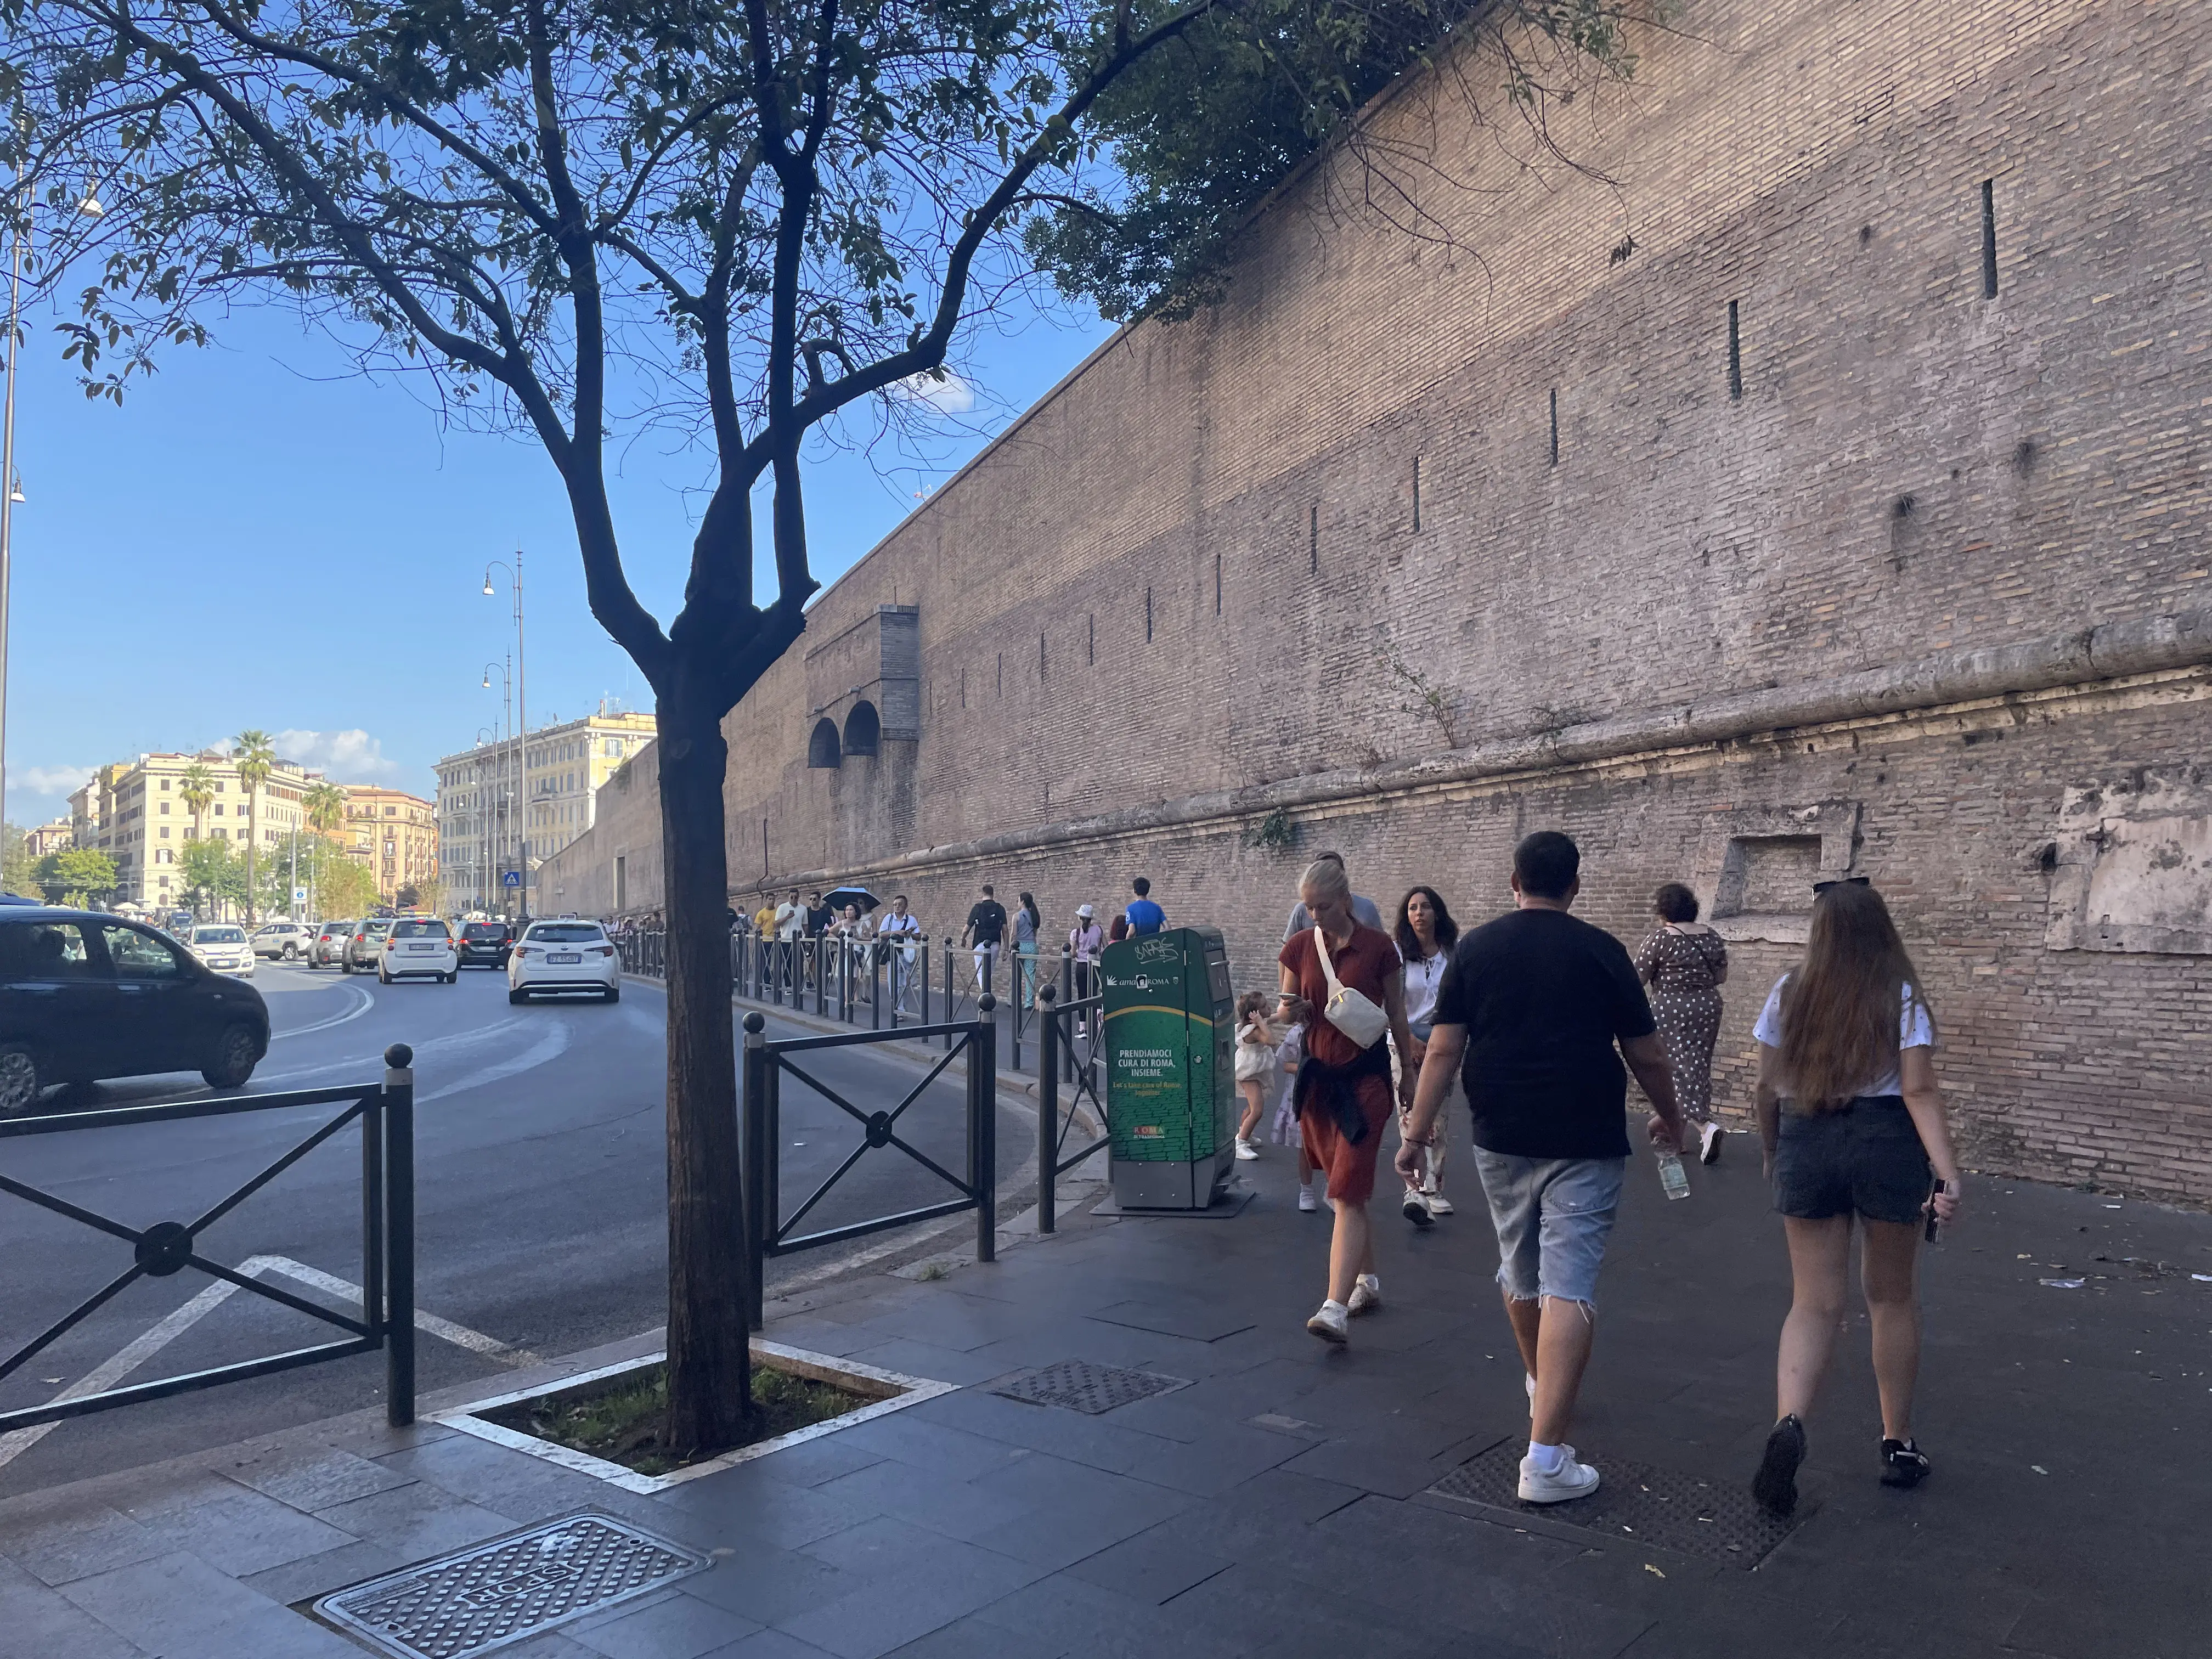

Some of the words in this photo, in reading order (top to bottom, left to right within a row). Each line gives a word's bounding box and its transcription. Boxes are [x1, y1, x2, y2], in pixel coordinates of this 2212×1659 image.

[1120, 1049, 1172, 1058] PRENDIAMOCI
[1118, 1059, 1138, 1067] CURA
[1141, 1059, 1149, 1067] DI
[1150, 1059, 1176, 1068] ROMA,
[1131, 1068, 1163, 1076] INSIEME.
